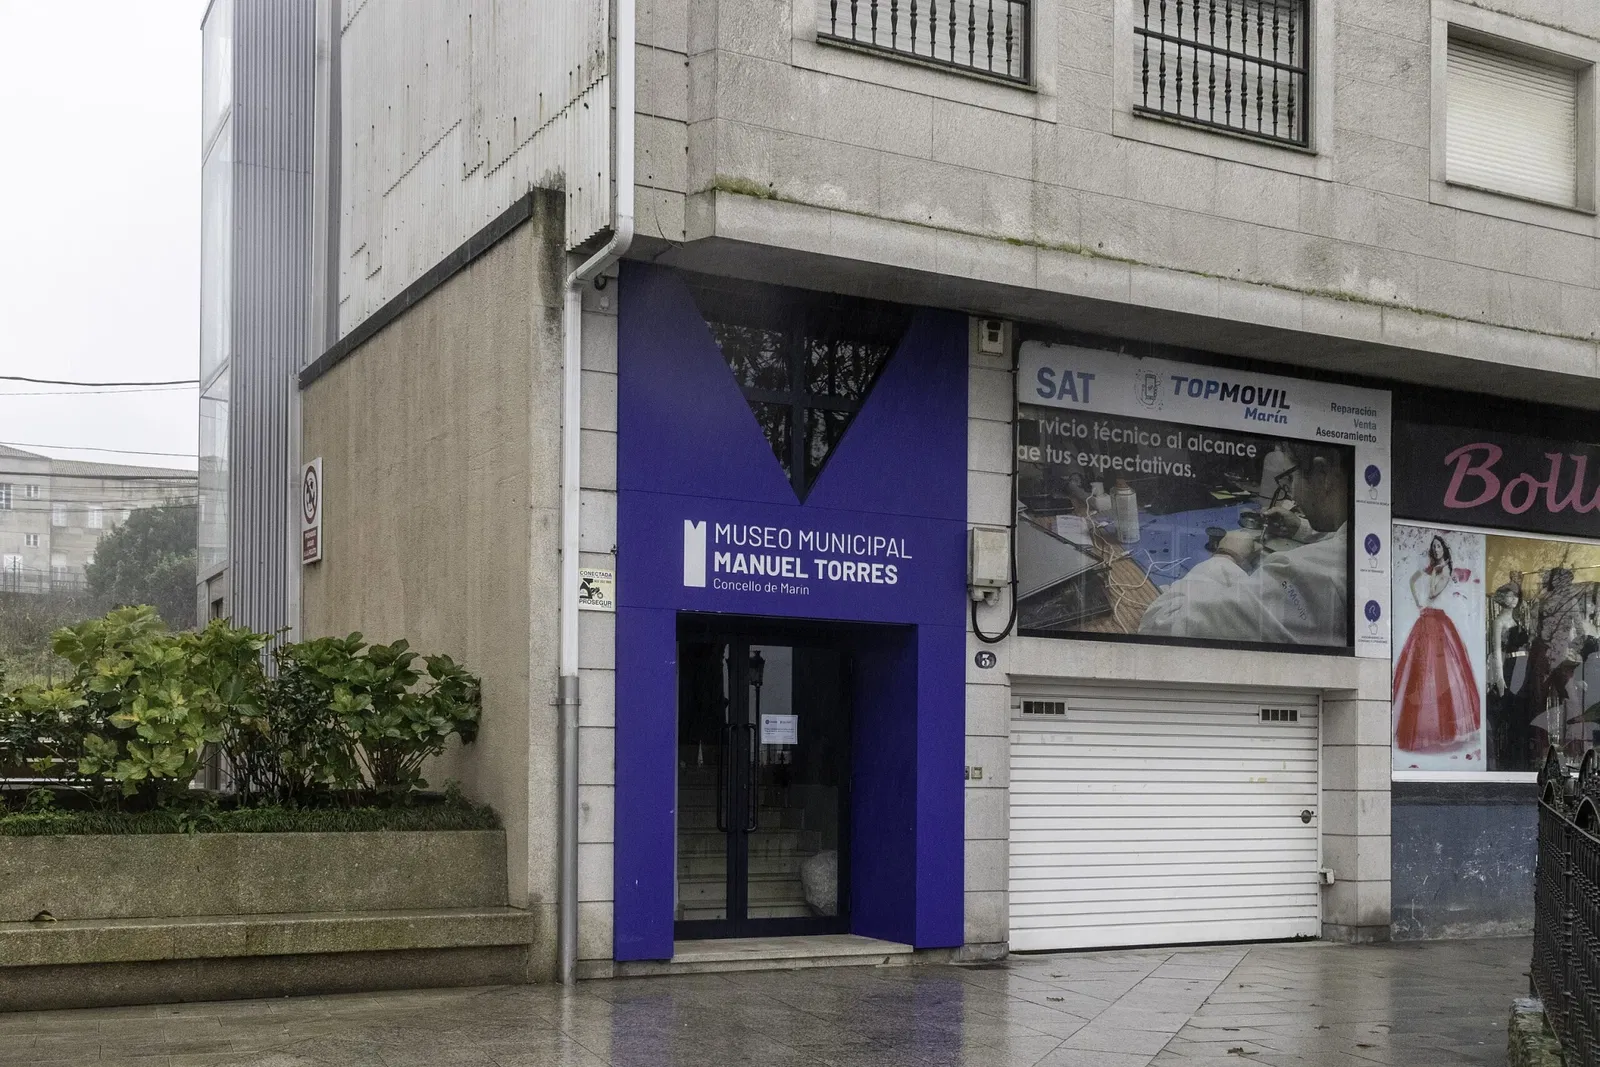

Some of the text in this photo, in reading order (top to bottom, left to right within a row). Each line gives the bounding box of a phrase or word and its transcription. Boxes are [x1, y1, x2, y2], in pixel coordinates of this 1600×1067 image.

[1036, 366, 1096, 404] SAT
[1170, 375, 1291, 410] TOPMOVIL
[1244, 406, 1289, 425] Marín
[1330, 402, 1378, 418] Reparación
[1038, 416, 1258, 458] rvicio técnico al alcance
[1315, 426, 1378, 444] Asesoramiento
[1353, 418, 1378, 431] Venta
[1045, 444, 1073, 465] tus
[1077, 451, 1197, 479] expectativas.
[1443, 442, 1600, 515] Boll
[714, 522, 913, 560] MUSEO MUNICIPAL
[713, 551, 898, 585] MANUEL TORRES
[713, 577, 762, 592] Concello
[764, 582, 778, 593] de
[579, 598, 612, 606] PROSEGUR
[981, 654, 990, 667] 3
